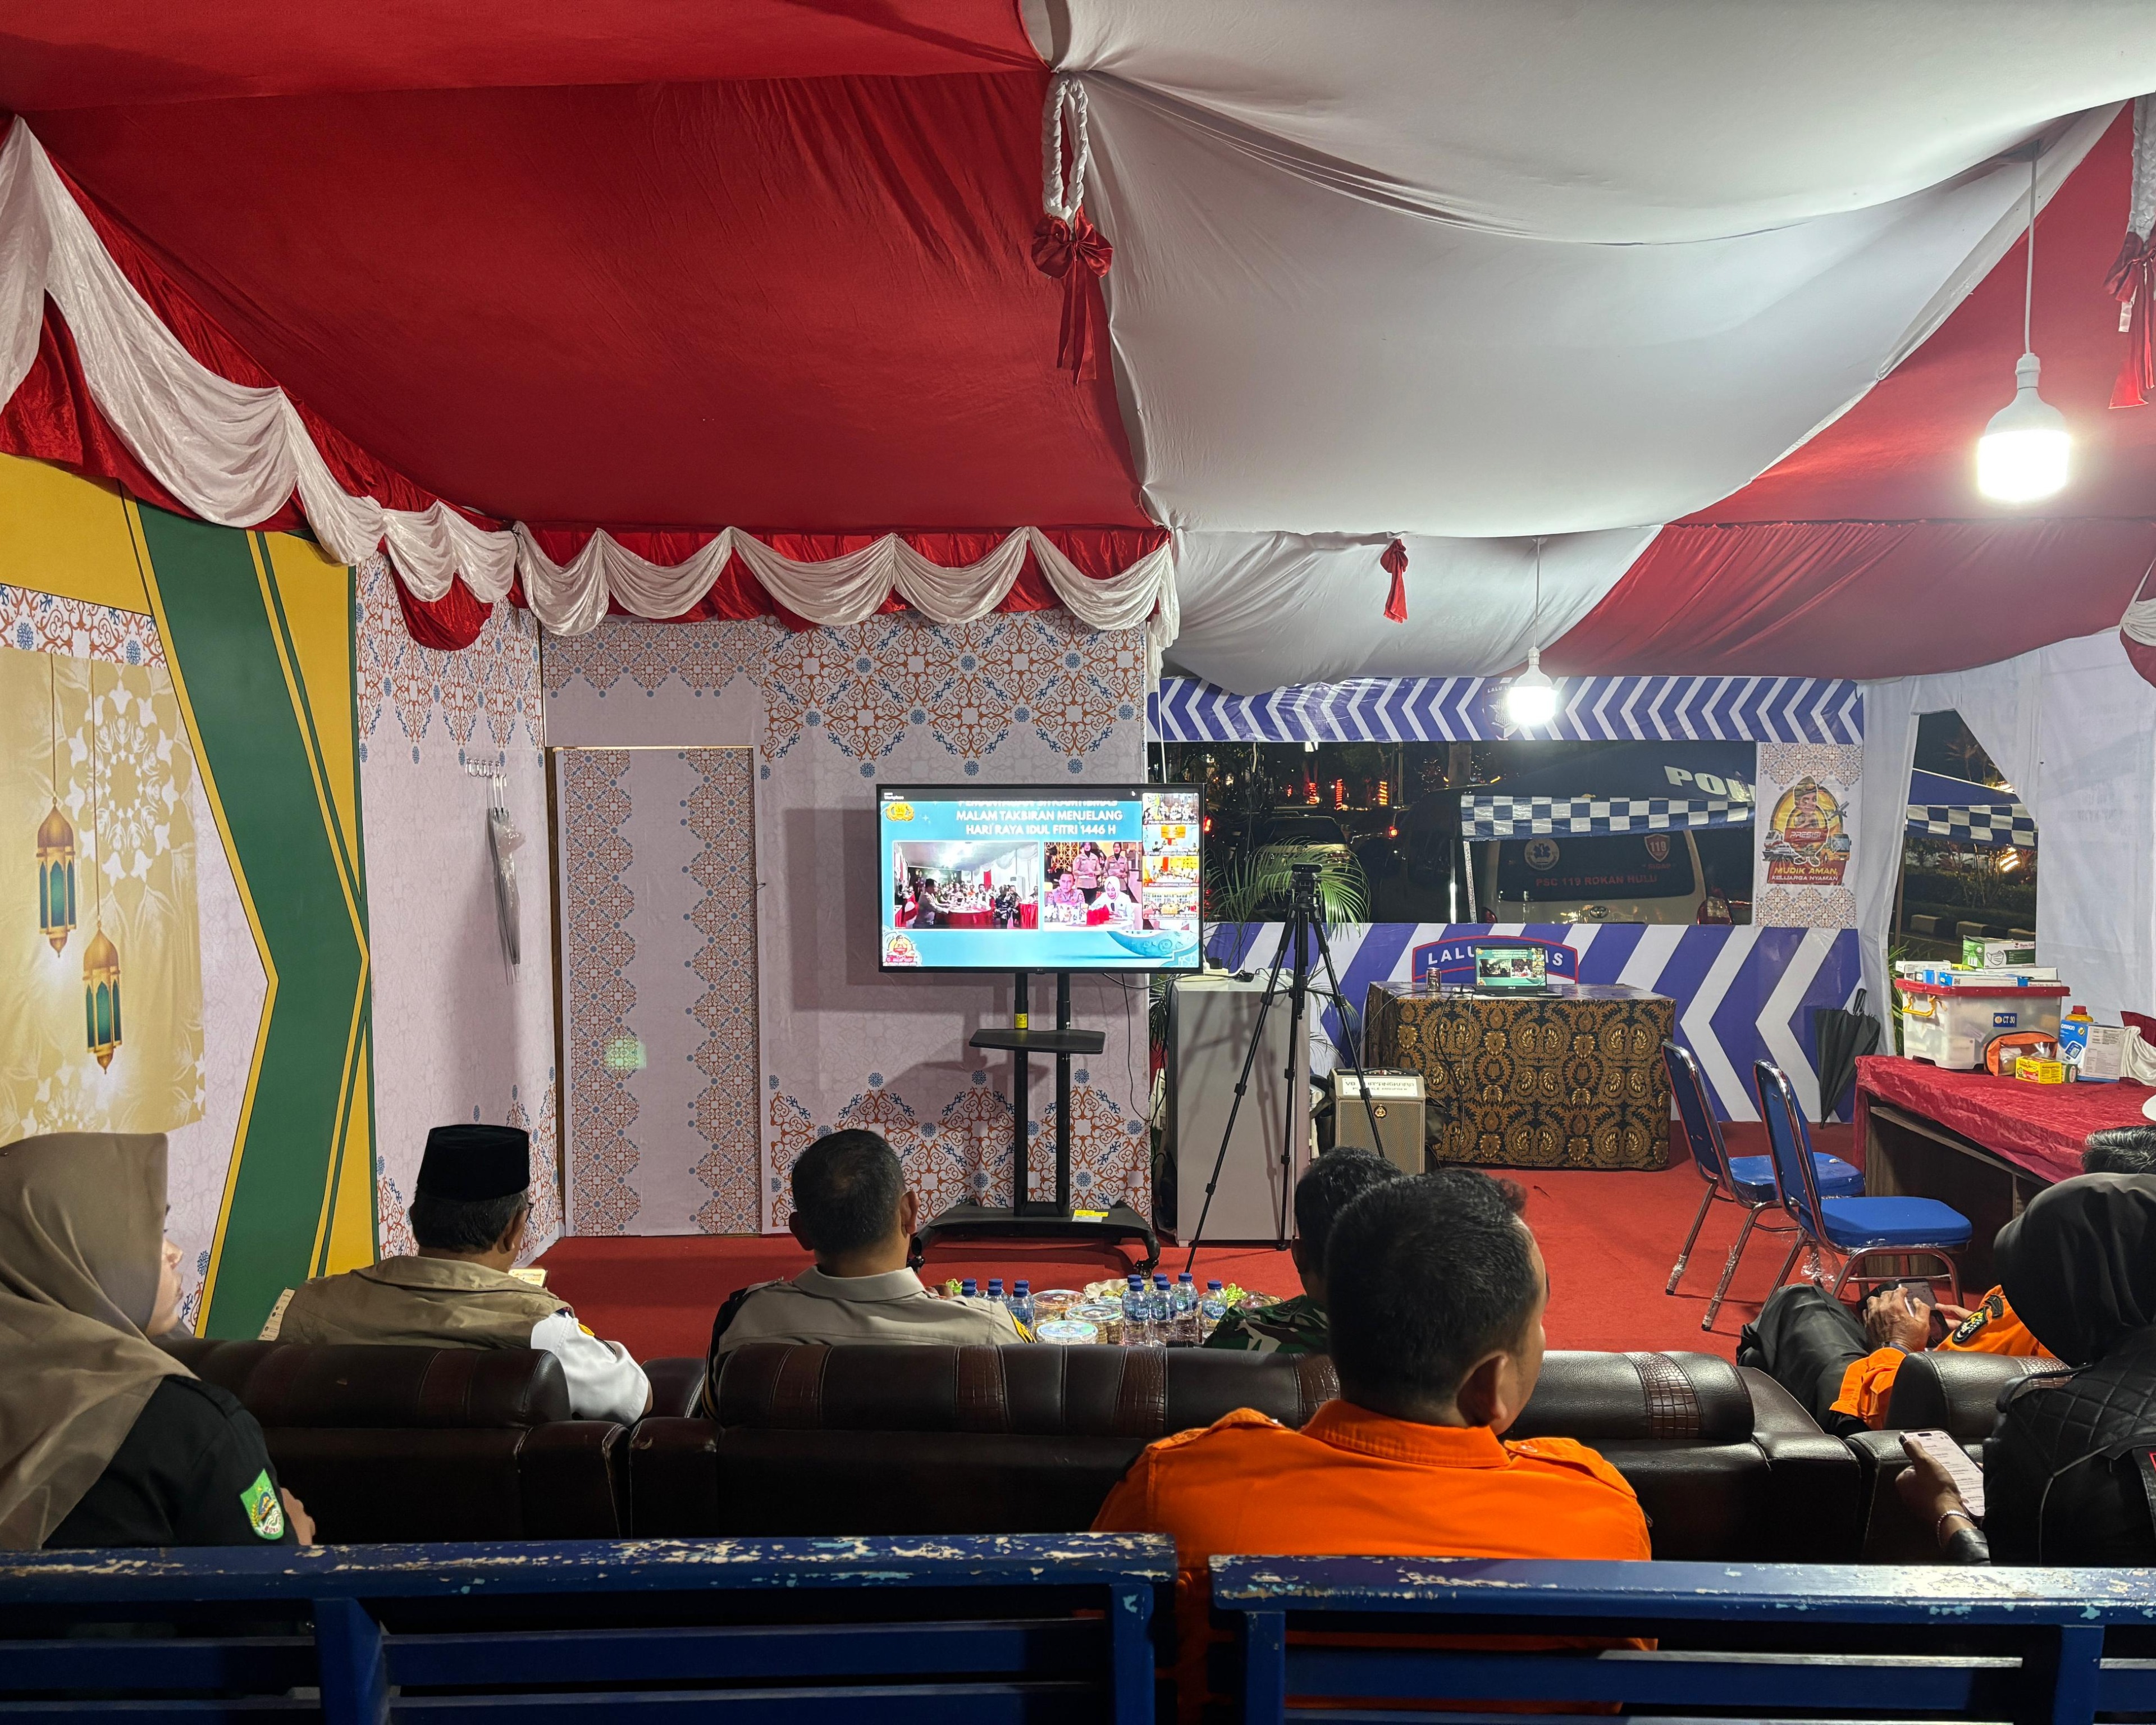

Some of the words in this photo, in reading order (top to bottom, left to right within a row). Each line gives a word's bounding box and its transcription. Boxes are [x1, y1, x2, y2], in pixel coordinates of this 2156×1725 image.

[956, 810, 997, 821] MALAM
[999, 810, 1054, 821] TAKBIRAN
[1057, 810, 1123, 821] MENJELANG
[966, 824, 992, 835] HARI
[995, 824, 1024, 835] RAYA
[1026, 824, 1050, 835] IDUL
[1053, 824, 1078, 835] FITRI
[1080, 824, 1106, 835] 1446
[1108, 824, 1116, 835] H
[1650, 842, 1667, 852] 119
[1808, 868, 1838, 876] AMAN,
[1536, 878, 1557, 887] PSC
[1562, 878, 1581, 886] 119
[1584, 876, 1624, 886] ROKAN
